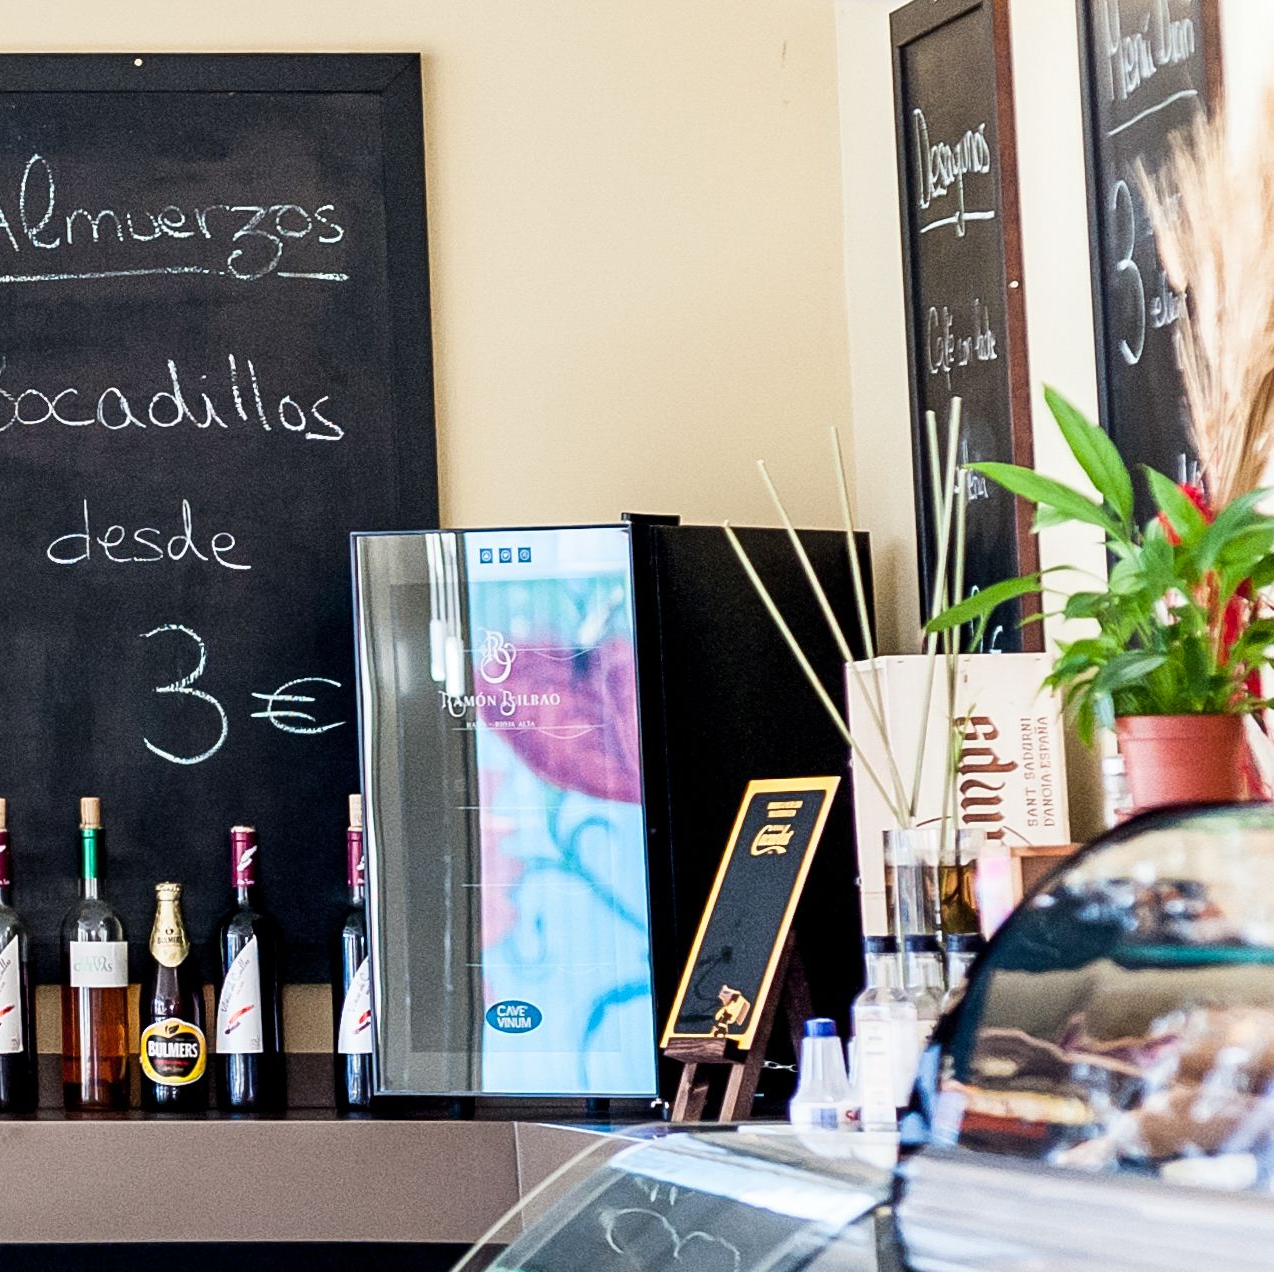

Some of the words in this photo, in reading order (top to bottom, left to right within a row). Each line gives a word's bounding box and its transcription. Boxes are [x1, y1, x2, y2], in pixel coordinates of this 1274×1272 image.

[47, 498, 252, 571] desde
[140, 623, 228, 766] 3
[438, 690, 497, 718] RAMÓN
[497, 688, 561, 716] BILBAO
[1020, 717, 1036, 780] SADURNI
[1035, 716, 1051, 768] ESPAÑA
[1026, 787, 1039, 827] SANT
[497, 1004, 528, 1017] CAVE
[497, 1016, 532, 1029] VINUM
[147, 1040, 199, 1058] BULMERS
